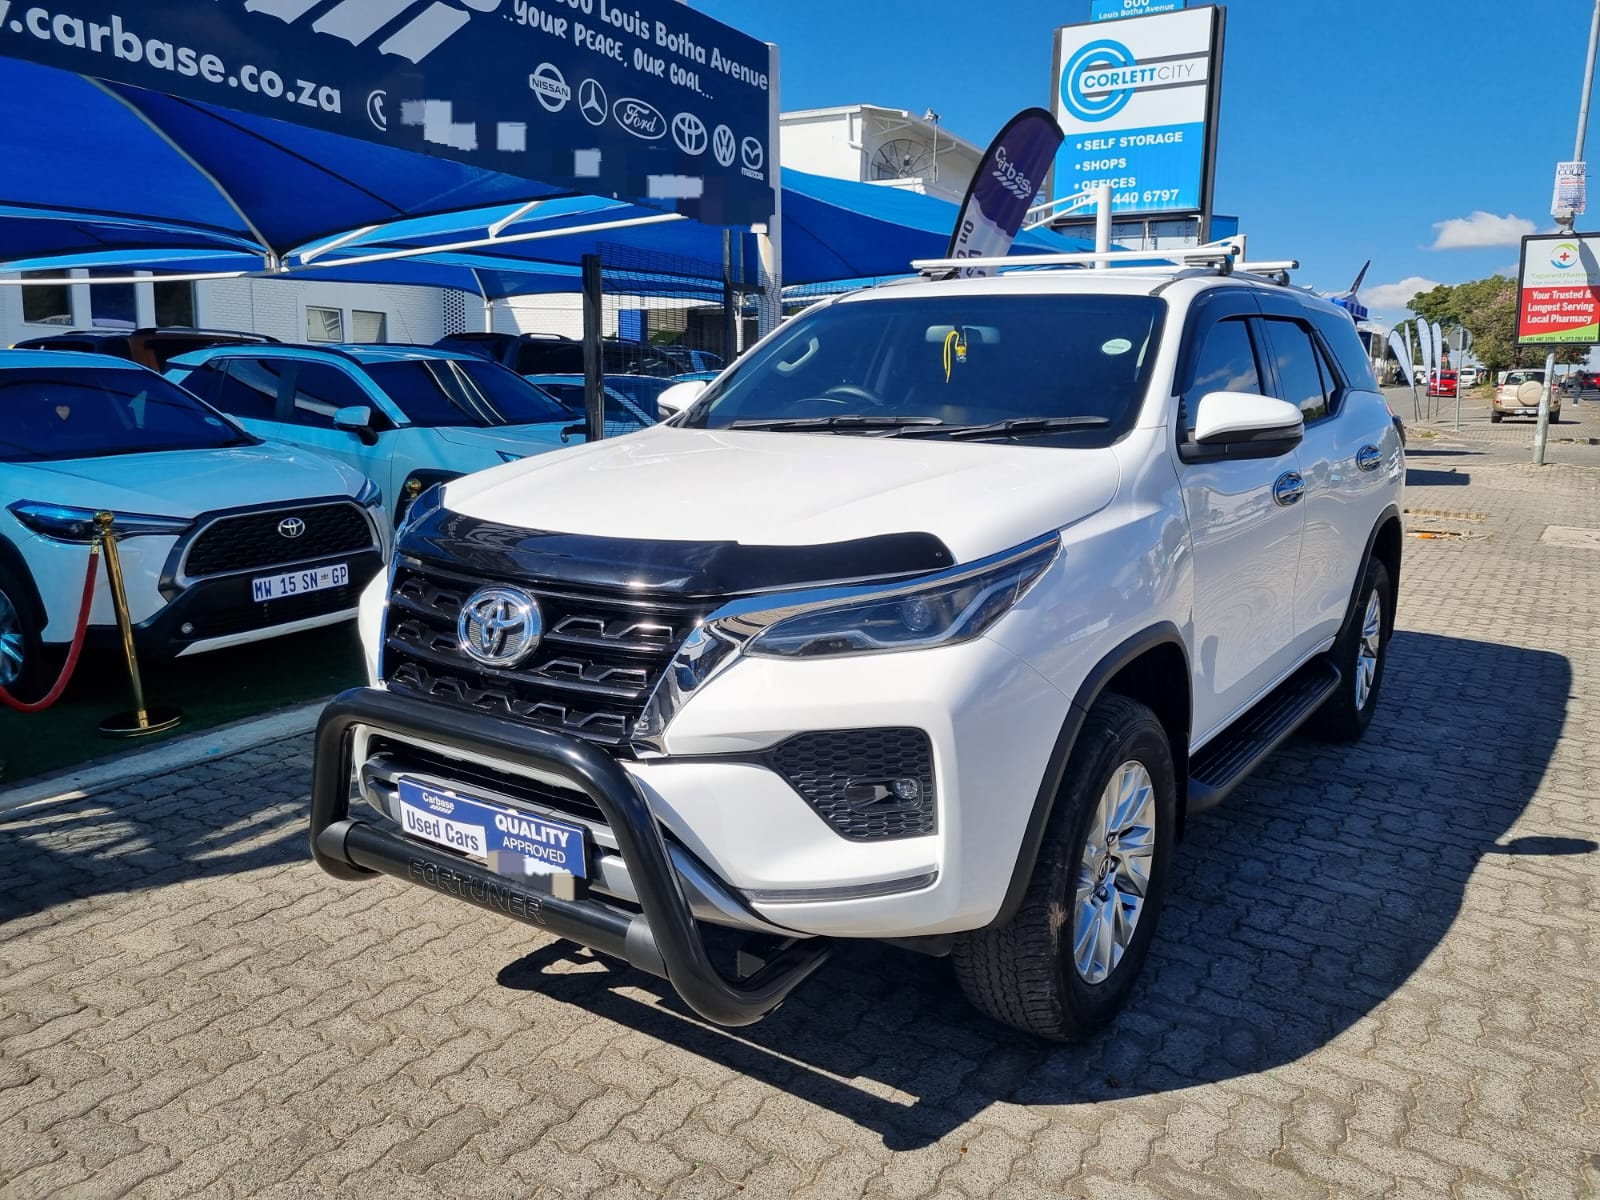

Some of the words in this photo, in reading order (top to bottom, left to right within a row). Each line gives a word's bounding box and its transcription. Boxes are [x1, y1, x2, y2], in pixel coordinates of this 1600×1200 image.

[1098, 11, 1118, 19] Louis
[1121, 7, 1143, 17] Botha
[1145, 3, 1175, 13] Avenue
[574, 21, 628, 68] PEACE,
[633, 47, 666, 78] OUR
[600, 0, 650, 40] Louis
[655, 20, 706, 65] Botha
[710, 47, 768, 90] Avenue
[531, 78, 569, 97] NISSAN
[623, 103, 657, 133] Ford
[1083, 138, 1116, 151] SELF
[1119, 131, 1184, 147] STORAGE
[1082, 157, 1127, 172] SHOPS
[1081, 177, 1137, 191] OFFICES
[1111, 192, 1139, 204] 440
[1143, 189, 1180, 203] 6797
[1532, 290, 1550, 300] Your
[1552, 289, 1584, 299] Trusted
[1585, 289, 1593, 299] &
[1527, 302, 1560, 313] Longest
[1562, 301, 1595, 312] Serving
[1527, 313, 1549, 324] Local
[1550, 312, 1593, 325] Pharmacy
[254, 579, 272, 600] MW
[280, 576, 297, 595] 15
[302, 571, 319, 590] SN
[331, 565, 347, 584] GP
[422, 792, 455, 810] Carbase
[406, 808, 441, 838] Used
[446, 819, 479, 852] Cars
[494, 813, 570, 848] QUALITY
[502, 836, 566, 864] APPROVED
[408, 856, 546, 925] FORTUNER
